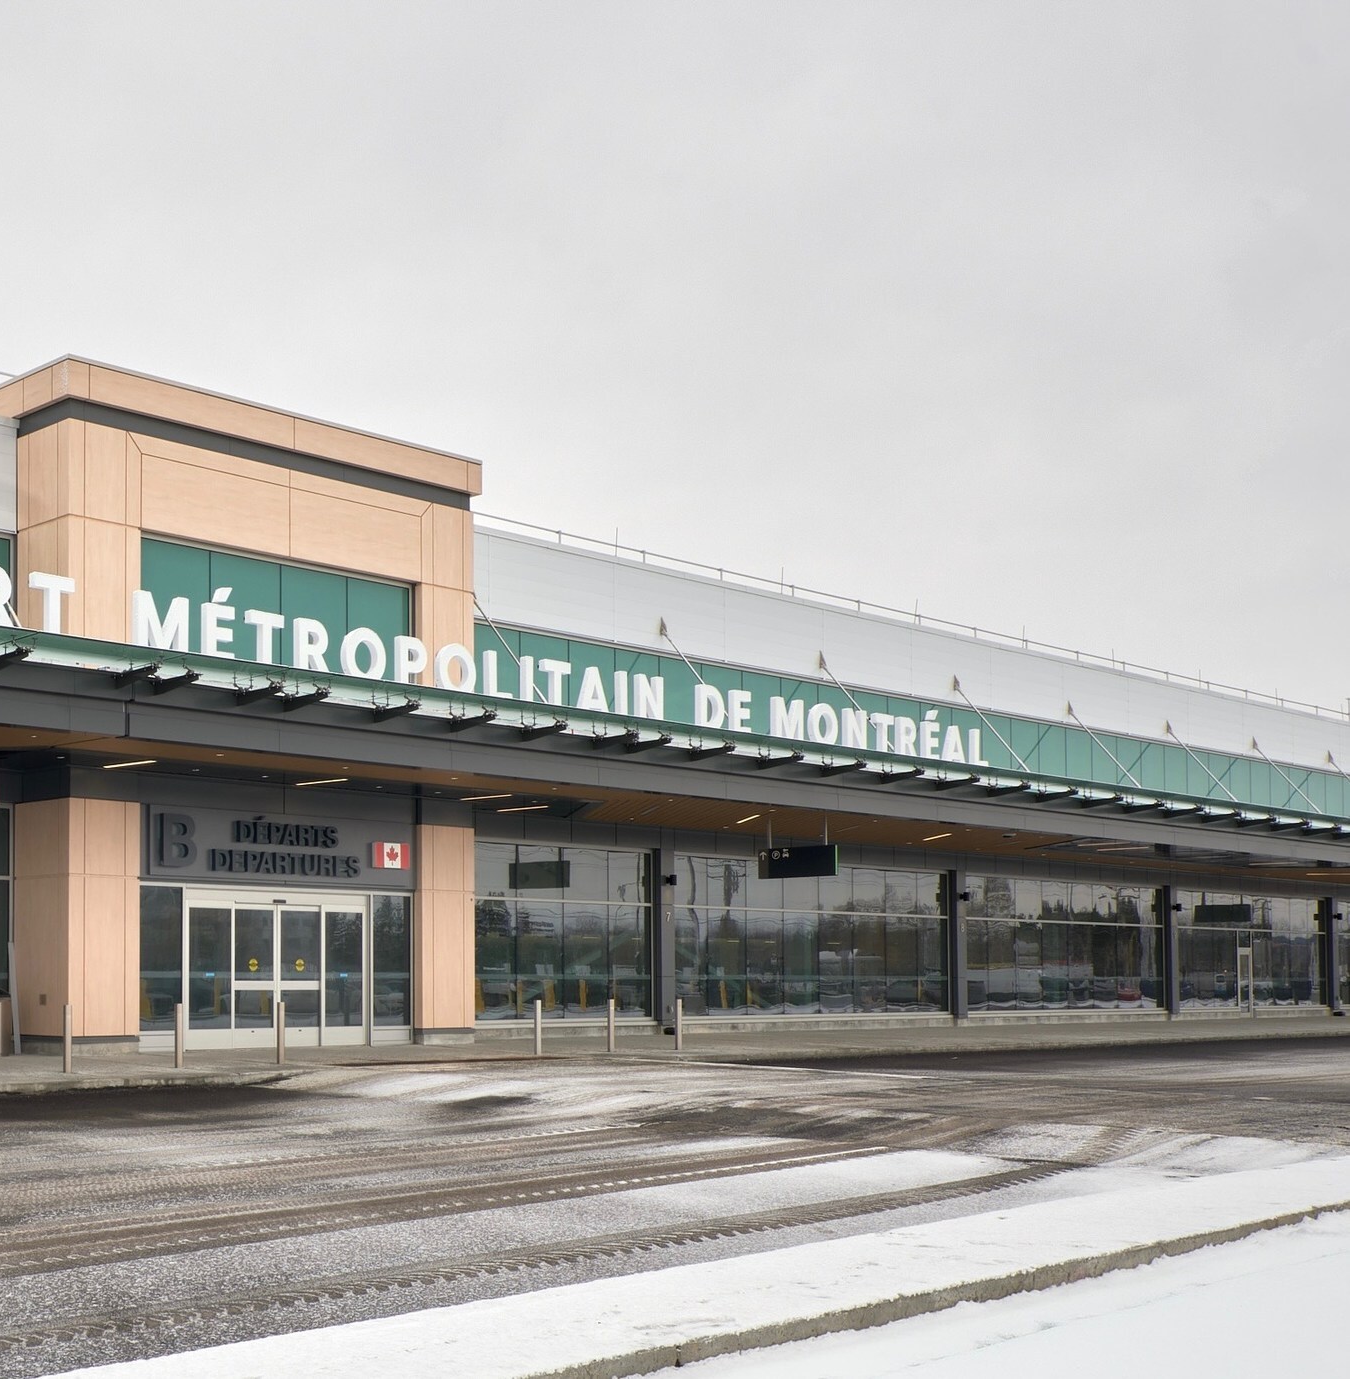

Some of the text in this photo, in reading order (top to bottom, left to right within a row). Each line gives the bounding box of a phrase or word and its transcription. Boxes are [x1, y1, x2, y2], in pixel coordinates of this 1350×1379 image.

[132, 586, 664, 720] MÉTROPOLITAIN
[694, 684, 752, 733] DE
[769, 696, 989, 767] MONTRÉAL
[160, 812, 197, 868] B
[232, 815, 340, 849] DÉPARTS
[207, 848, 362, 879] DEPARTURES
[665, 911, 671, 922] 7
